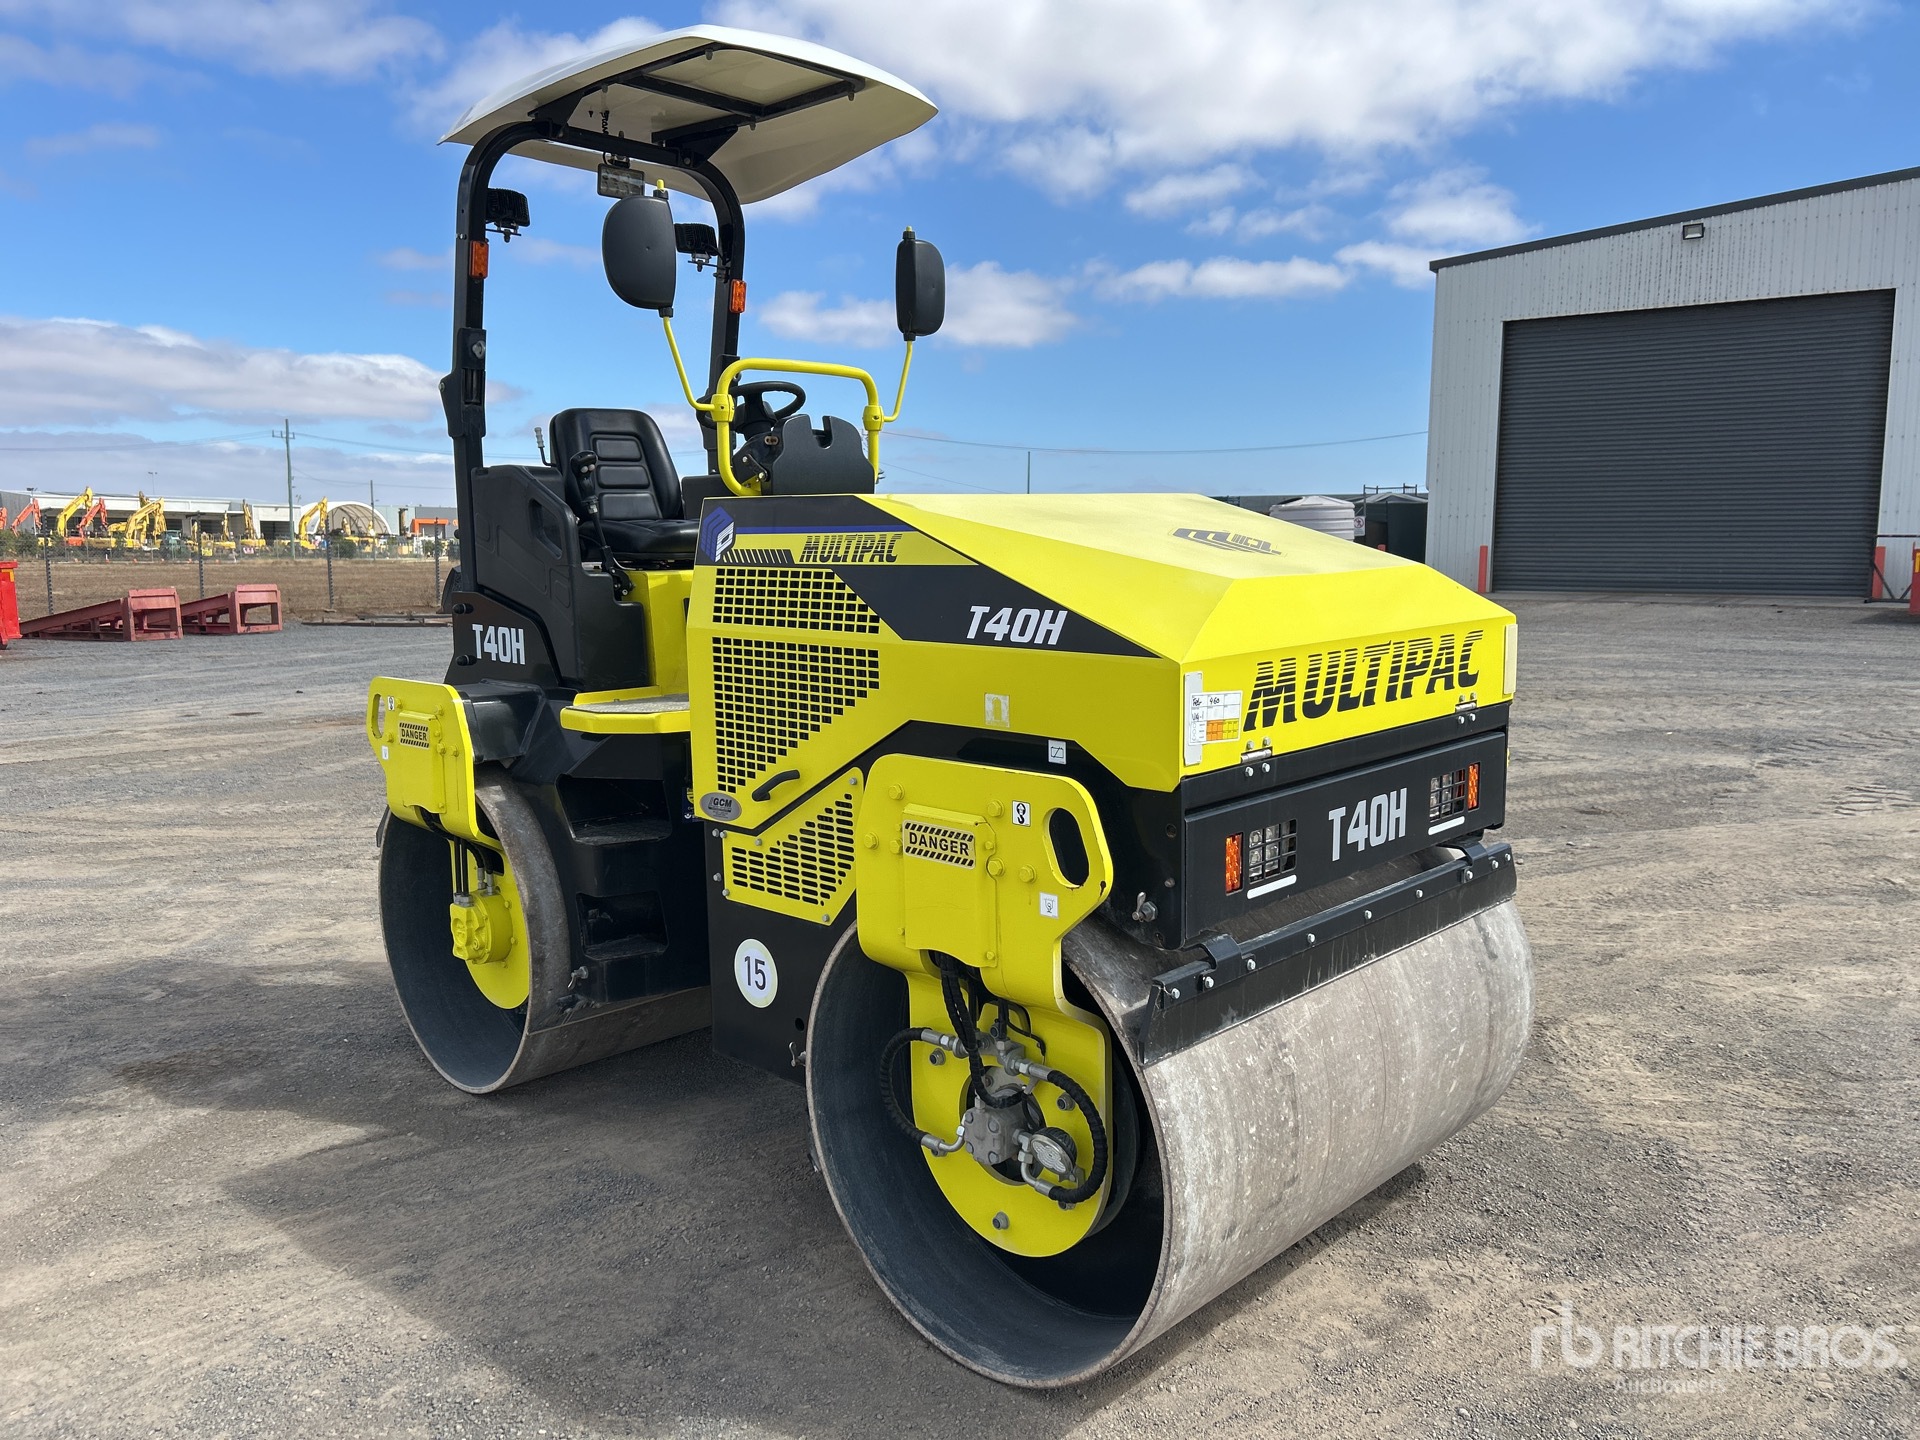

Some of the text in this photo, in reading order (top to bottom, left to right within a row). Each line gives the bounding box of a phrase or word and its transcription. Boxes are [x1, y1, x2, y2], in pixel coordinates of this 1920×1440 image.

[799, 534, 904, 563] MULTIPAC
[966, 605, 1068, 646] T40H
[472, 624, 526, 665] T40H
[1243, 629, 1484, 732] MULTIPAC
[401, 728, 428, 742] DANGER
[713, 797, 733, 808] GCM
[1328, 788, 1408, 862] T40H
[908, 831, 971, 857] DANGER
[744, 955, 767, 991] 15
